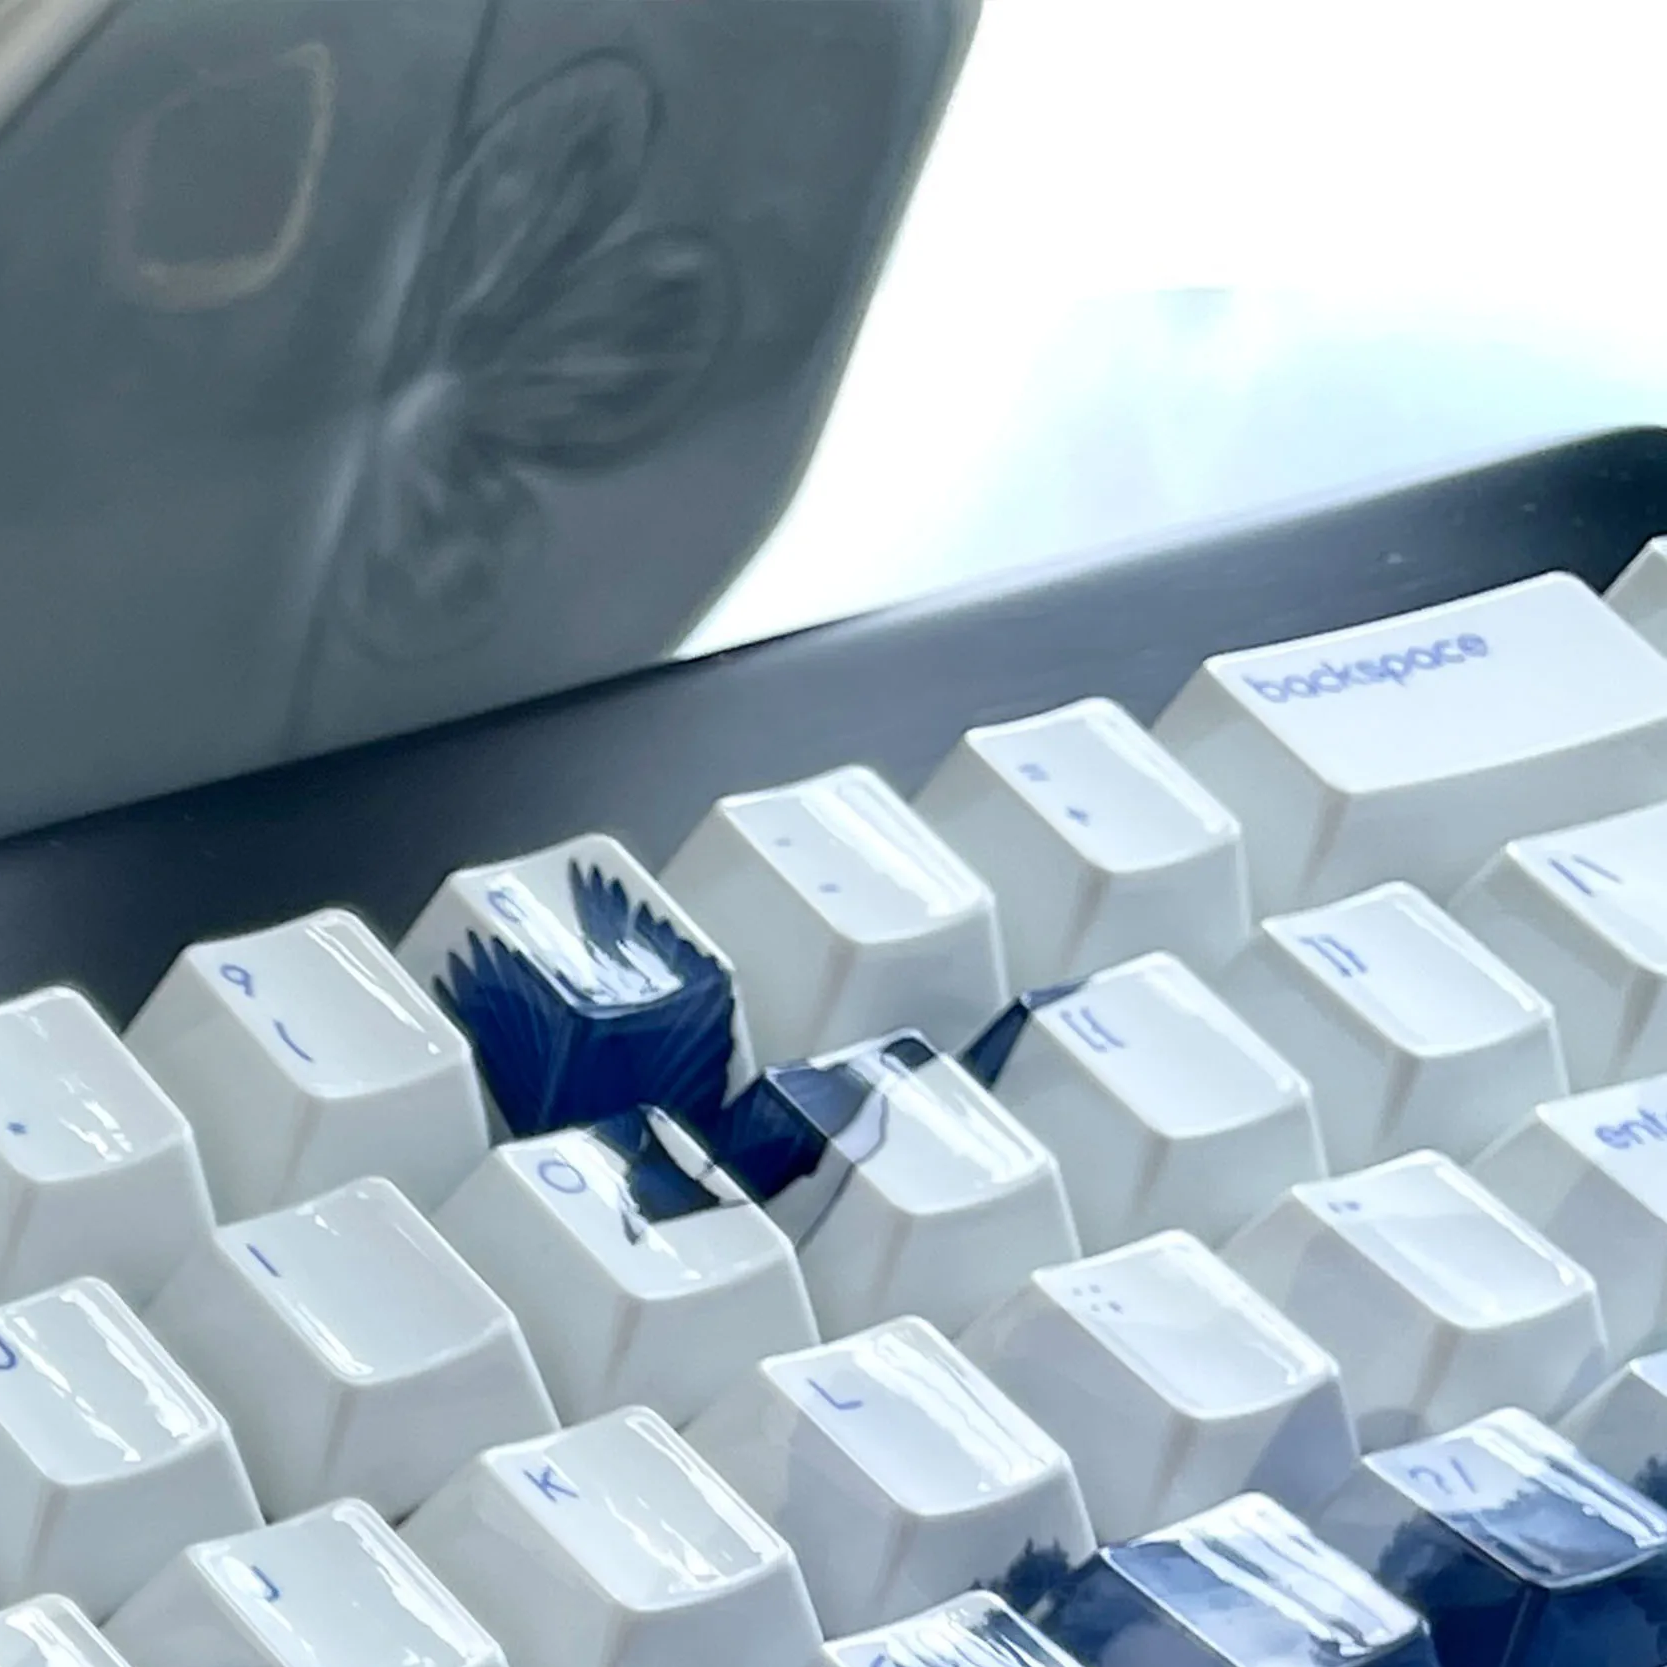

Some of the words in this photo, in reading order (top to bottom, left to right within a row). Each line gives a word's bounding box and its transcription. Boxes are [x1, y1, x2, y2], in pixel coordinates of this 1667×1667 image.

[1241, 632, 1489, 703] backspace
[220, 962, 255, 998] 9
[810, 1379, 865, 1413] L
[527, 1466, 576, 1503] K
